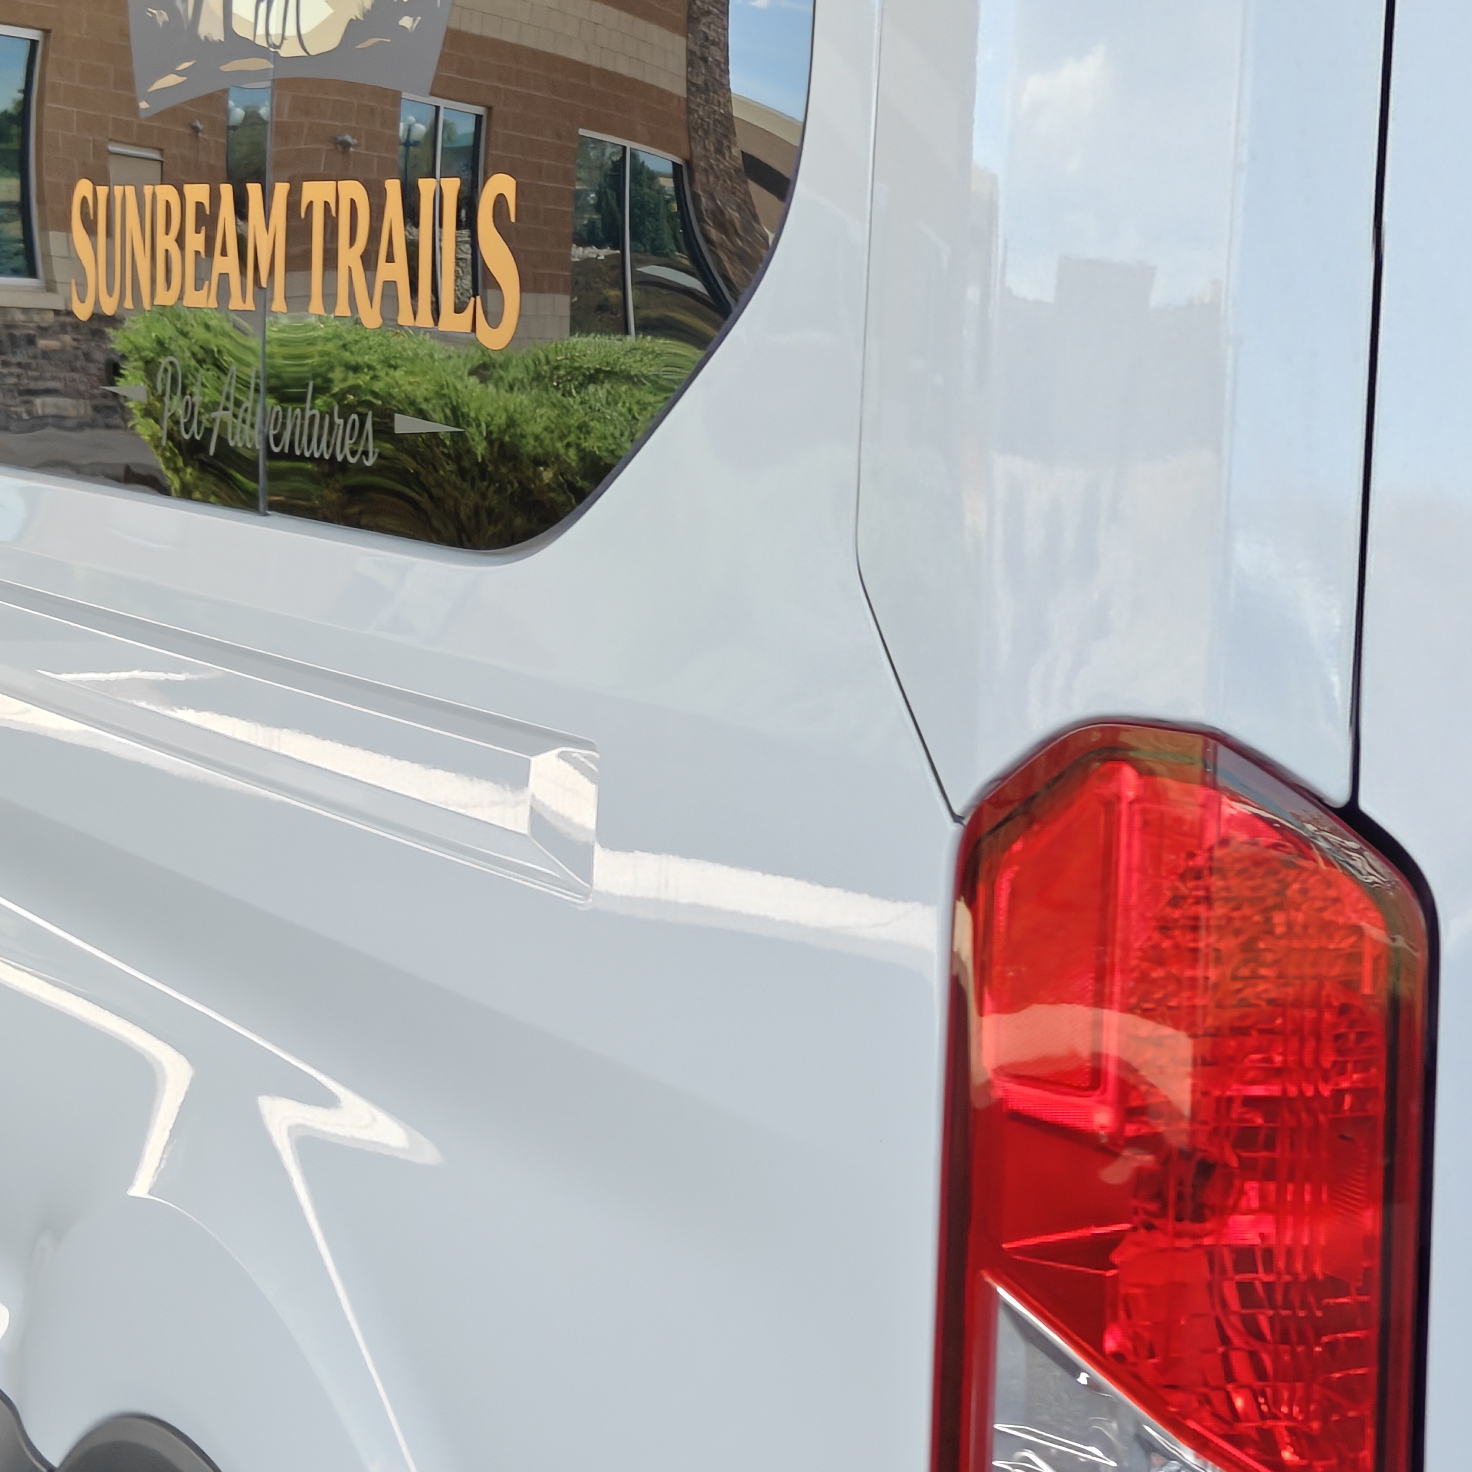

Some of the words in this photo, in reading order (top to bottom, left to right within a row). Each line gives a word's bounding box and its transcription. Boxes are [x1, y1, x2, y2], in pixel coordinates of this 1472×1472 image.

[70, 177, 291, 322] SUNBEAM
[300, 172, 521, 351] TRAILS
[155, 355, 205, 444] Pet
[208, 358, 380, 468] Adventures
